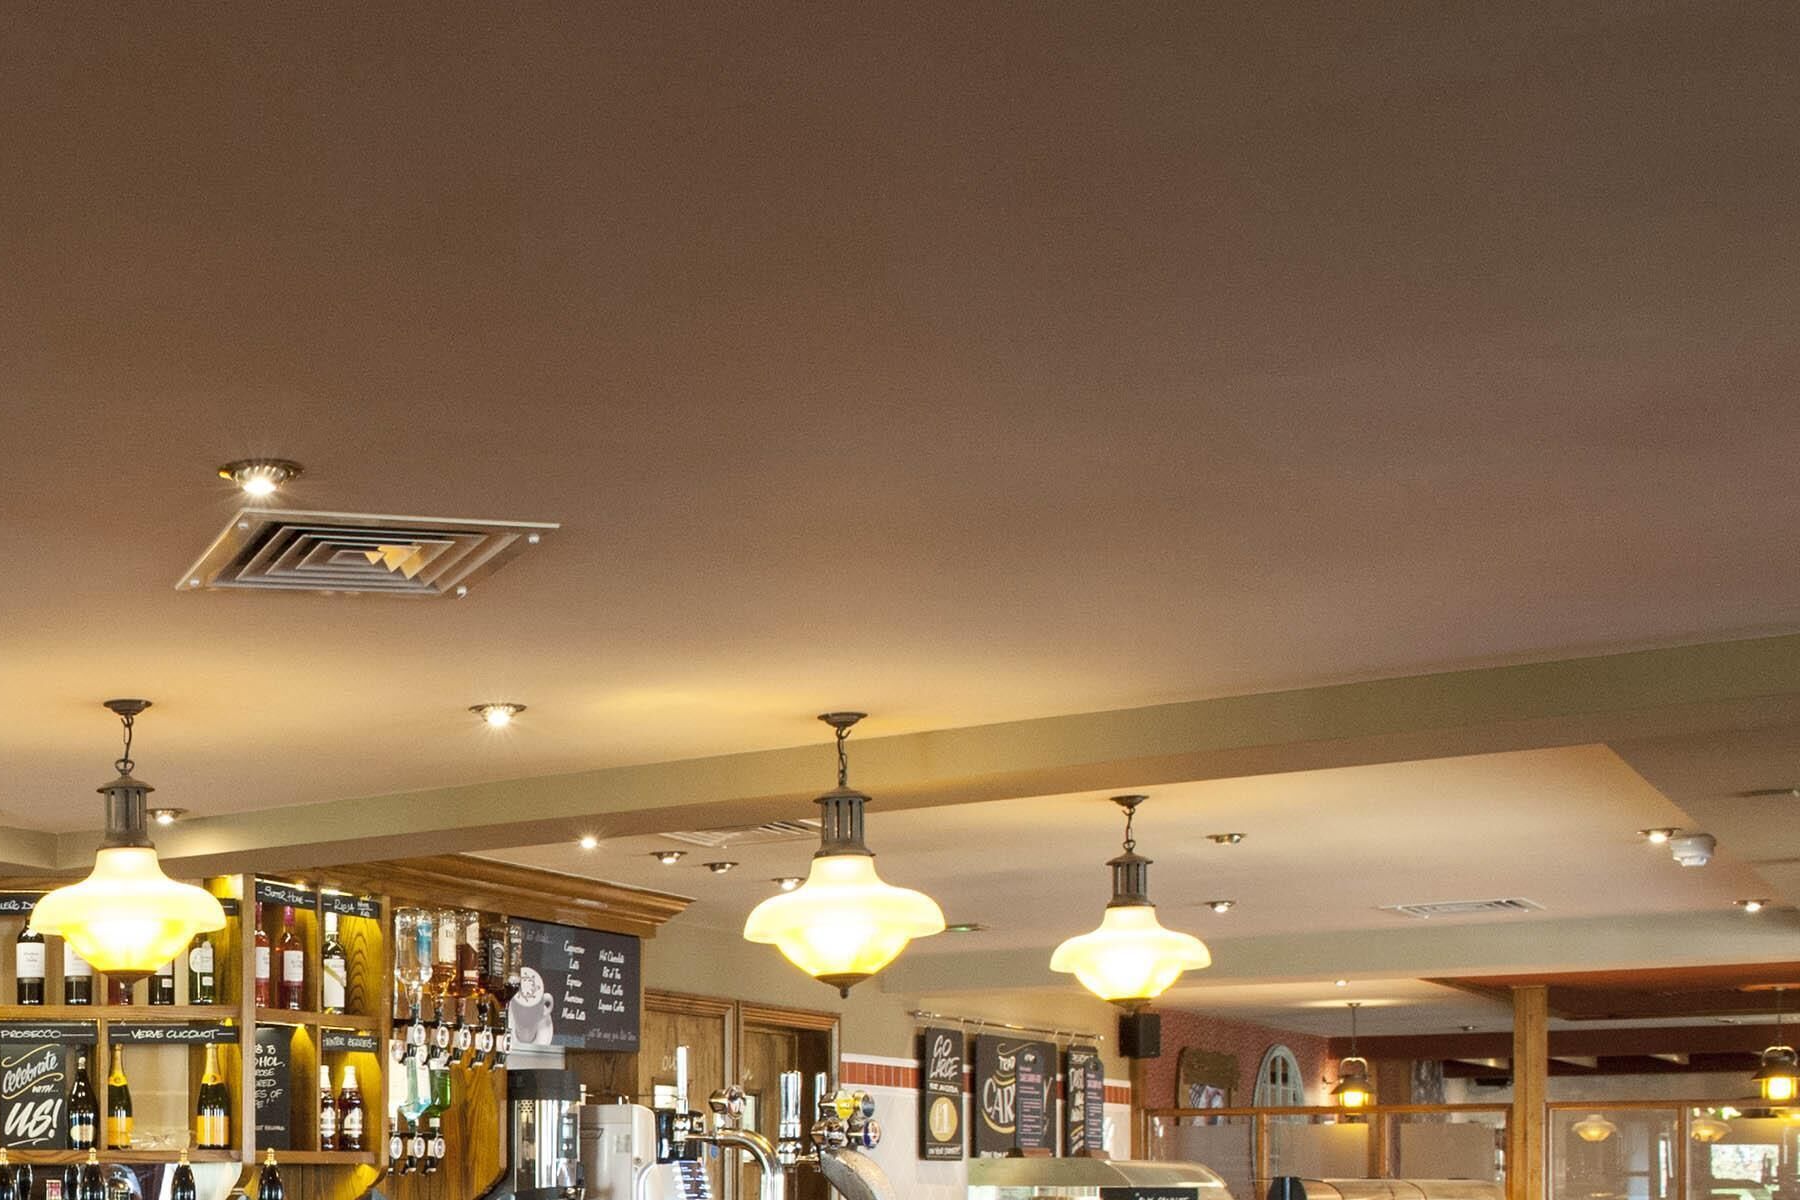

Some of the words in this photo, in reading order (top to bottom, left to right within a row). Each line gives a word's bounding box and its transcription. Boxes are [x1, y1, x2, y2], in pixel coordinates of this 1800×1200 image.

[0, 1029, 62, 1039] PROSECCO
[933, 1034, 952, 1058] GO
[3, 1051, 59, 1094] Celebrate
[929, 1057, 960, 1080] LARGE
[983, 1077, 1053, 1124] CARY
[4, 1098, 63, 1138] US!
